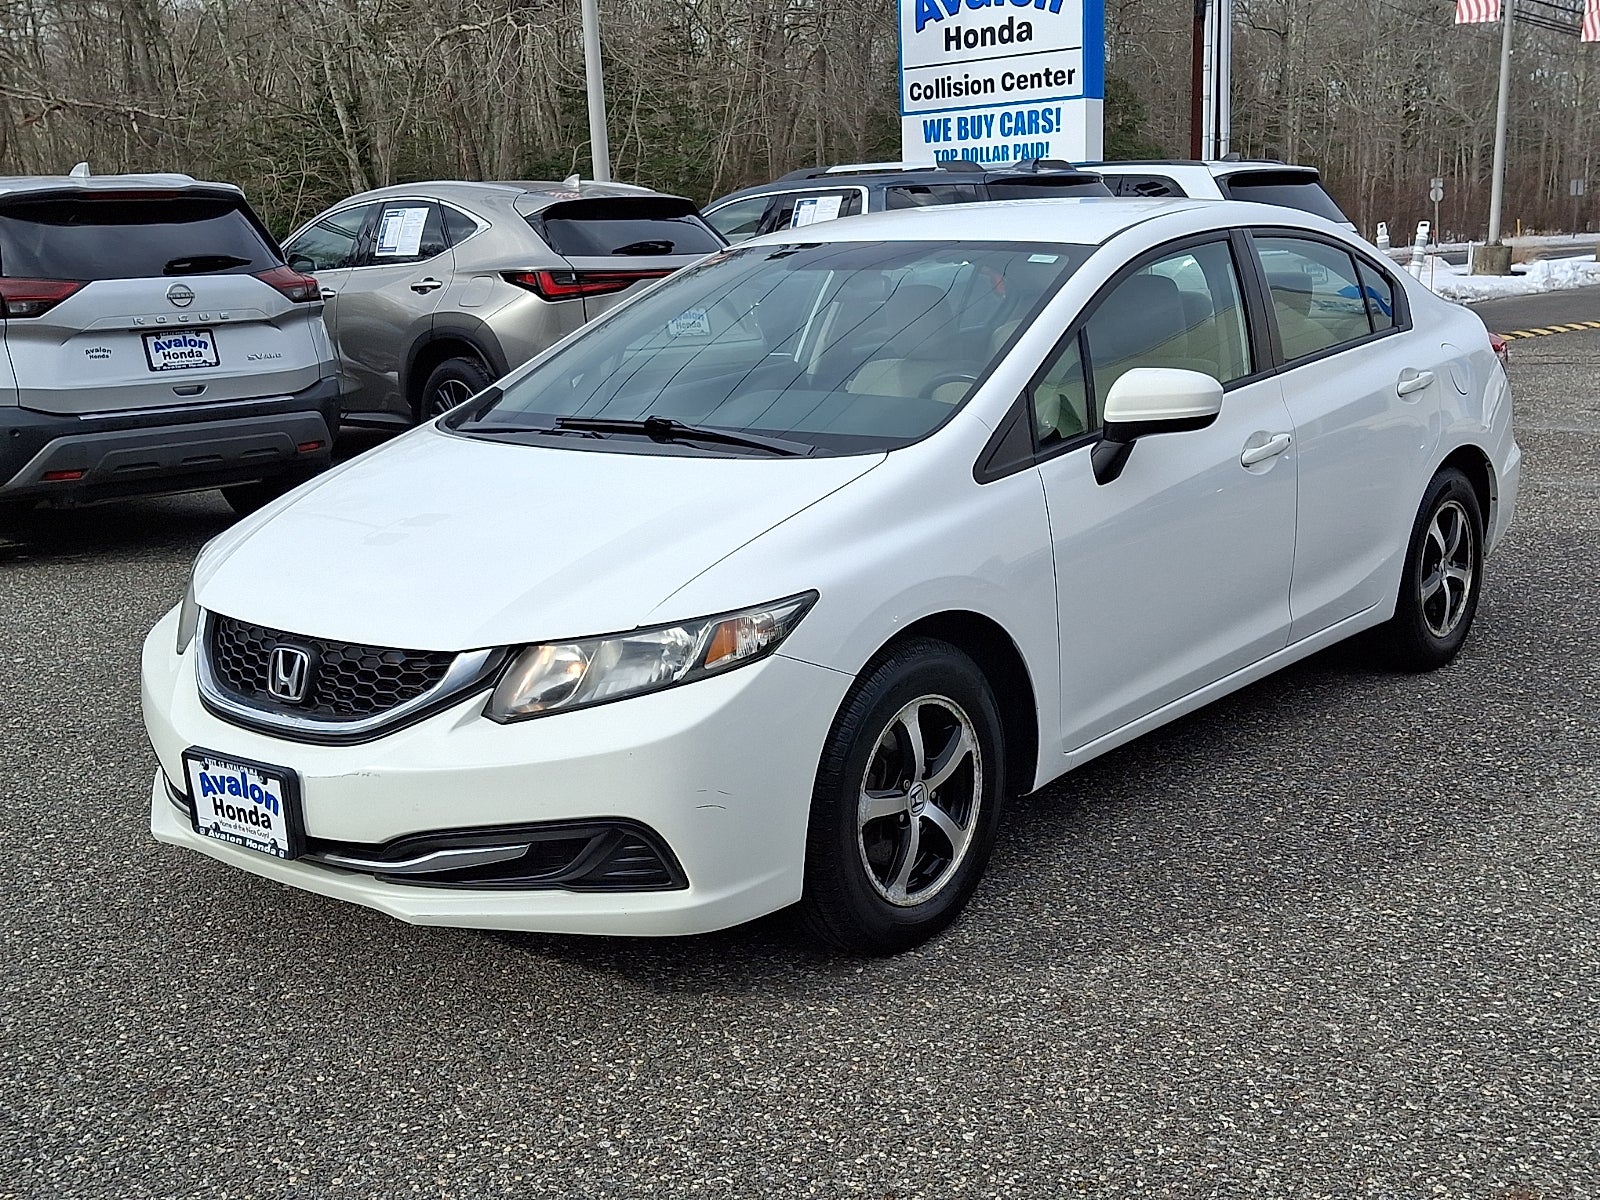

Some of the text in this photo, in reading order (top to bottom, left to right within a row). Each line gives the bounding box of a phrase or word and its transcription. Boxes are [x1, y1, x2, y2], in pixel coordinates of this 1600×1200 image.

[944, 16, 1033, 51] Honda
[909, 67, 1076, 101] Collision Center
[923, 107, 1061, 143] WE BUY CARS!
[934, 141, 1050, 163] TOP DOLLAR PAID!
[133, 312, 230, 325] ROGUE
[85, 346, 112, 355] Avalon
[153, 335, 208, 353] Avalon
[162, 348, 203, 360] Honda
[199, 771, 279, 817] Avalon
[212, 797, 272, 831] Honda
[208, 830, 277, 855] Avalon Honda
